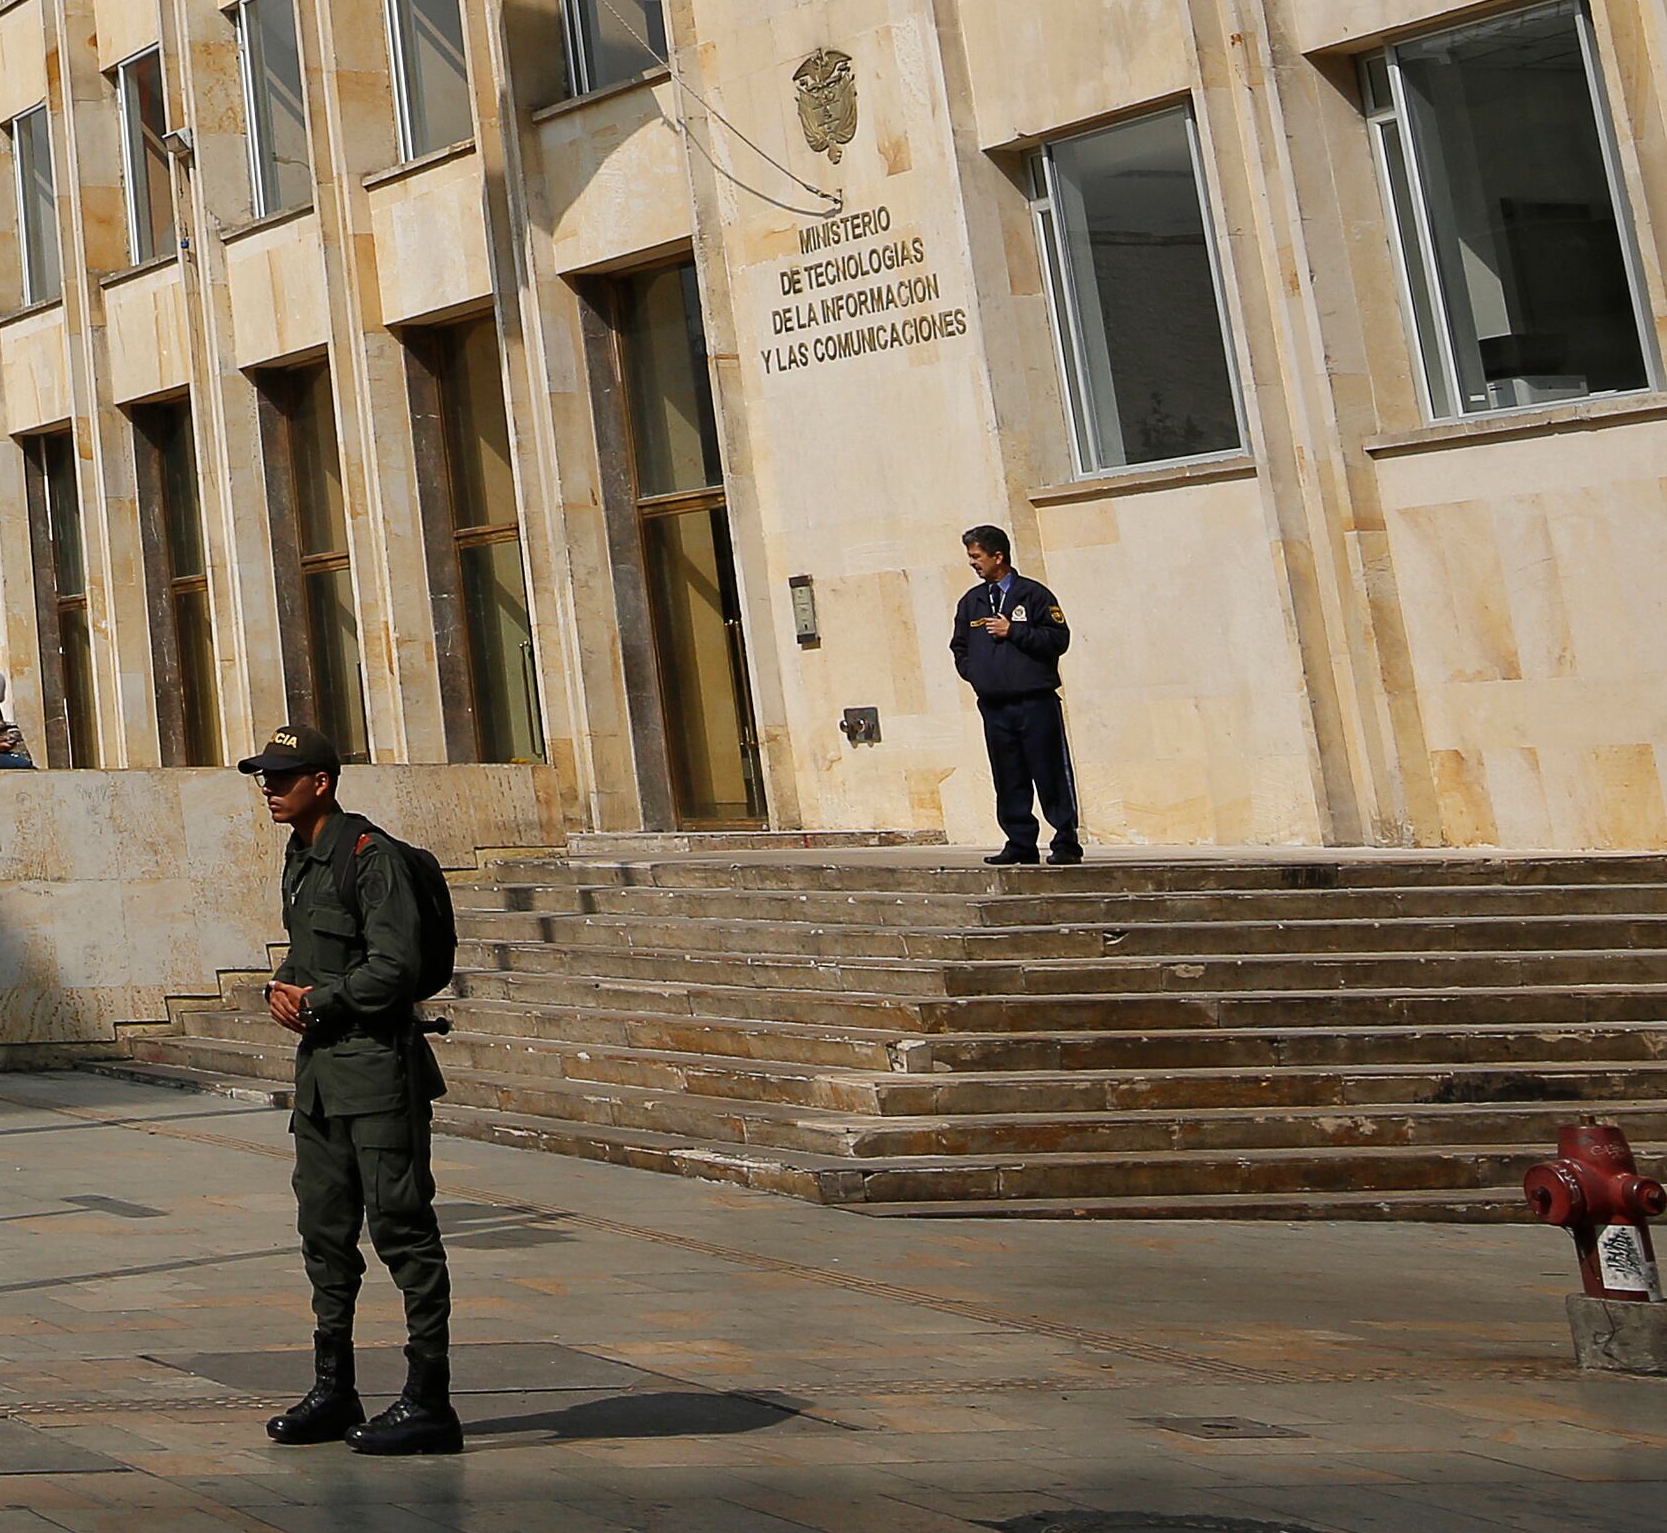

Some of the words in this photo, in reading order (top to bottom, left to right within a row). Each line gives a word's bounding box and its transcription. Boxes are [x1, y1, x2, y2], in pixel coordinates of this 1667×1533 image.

[798, 206, 891, 255] MINISTERIO
[780, 269, 803, 296] DE
[804, 237, 924, 290] TECNOLOGIAS
[772, 308, 794, 335] DE
[796, 303, 819, 330] LA
[821, 273, 940, 324] INFORMACION
[761, 349, 772, 374] Y
[776, 342, 808, 372] LAS
[814, 308, 967, 364] COMUNICACIONES
